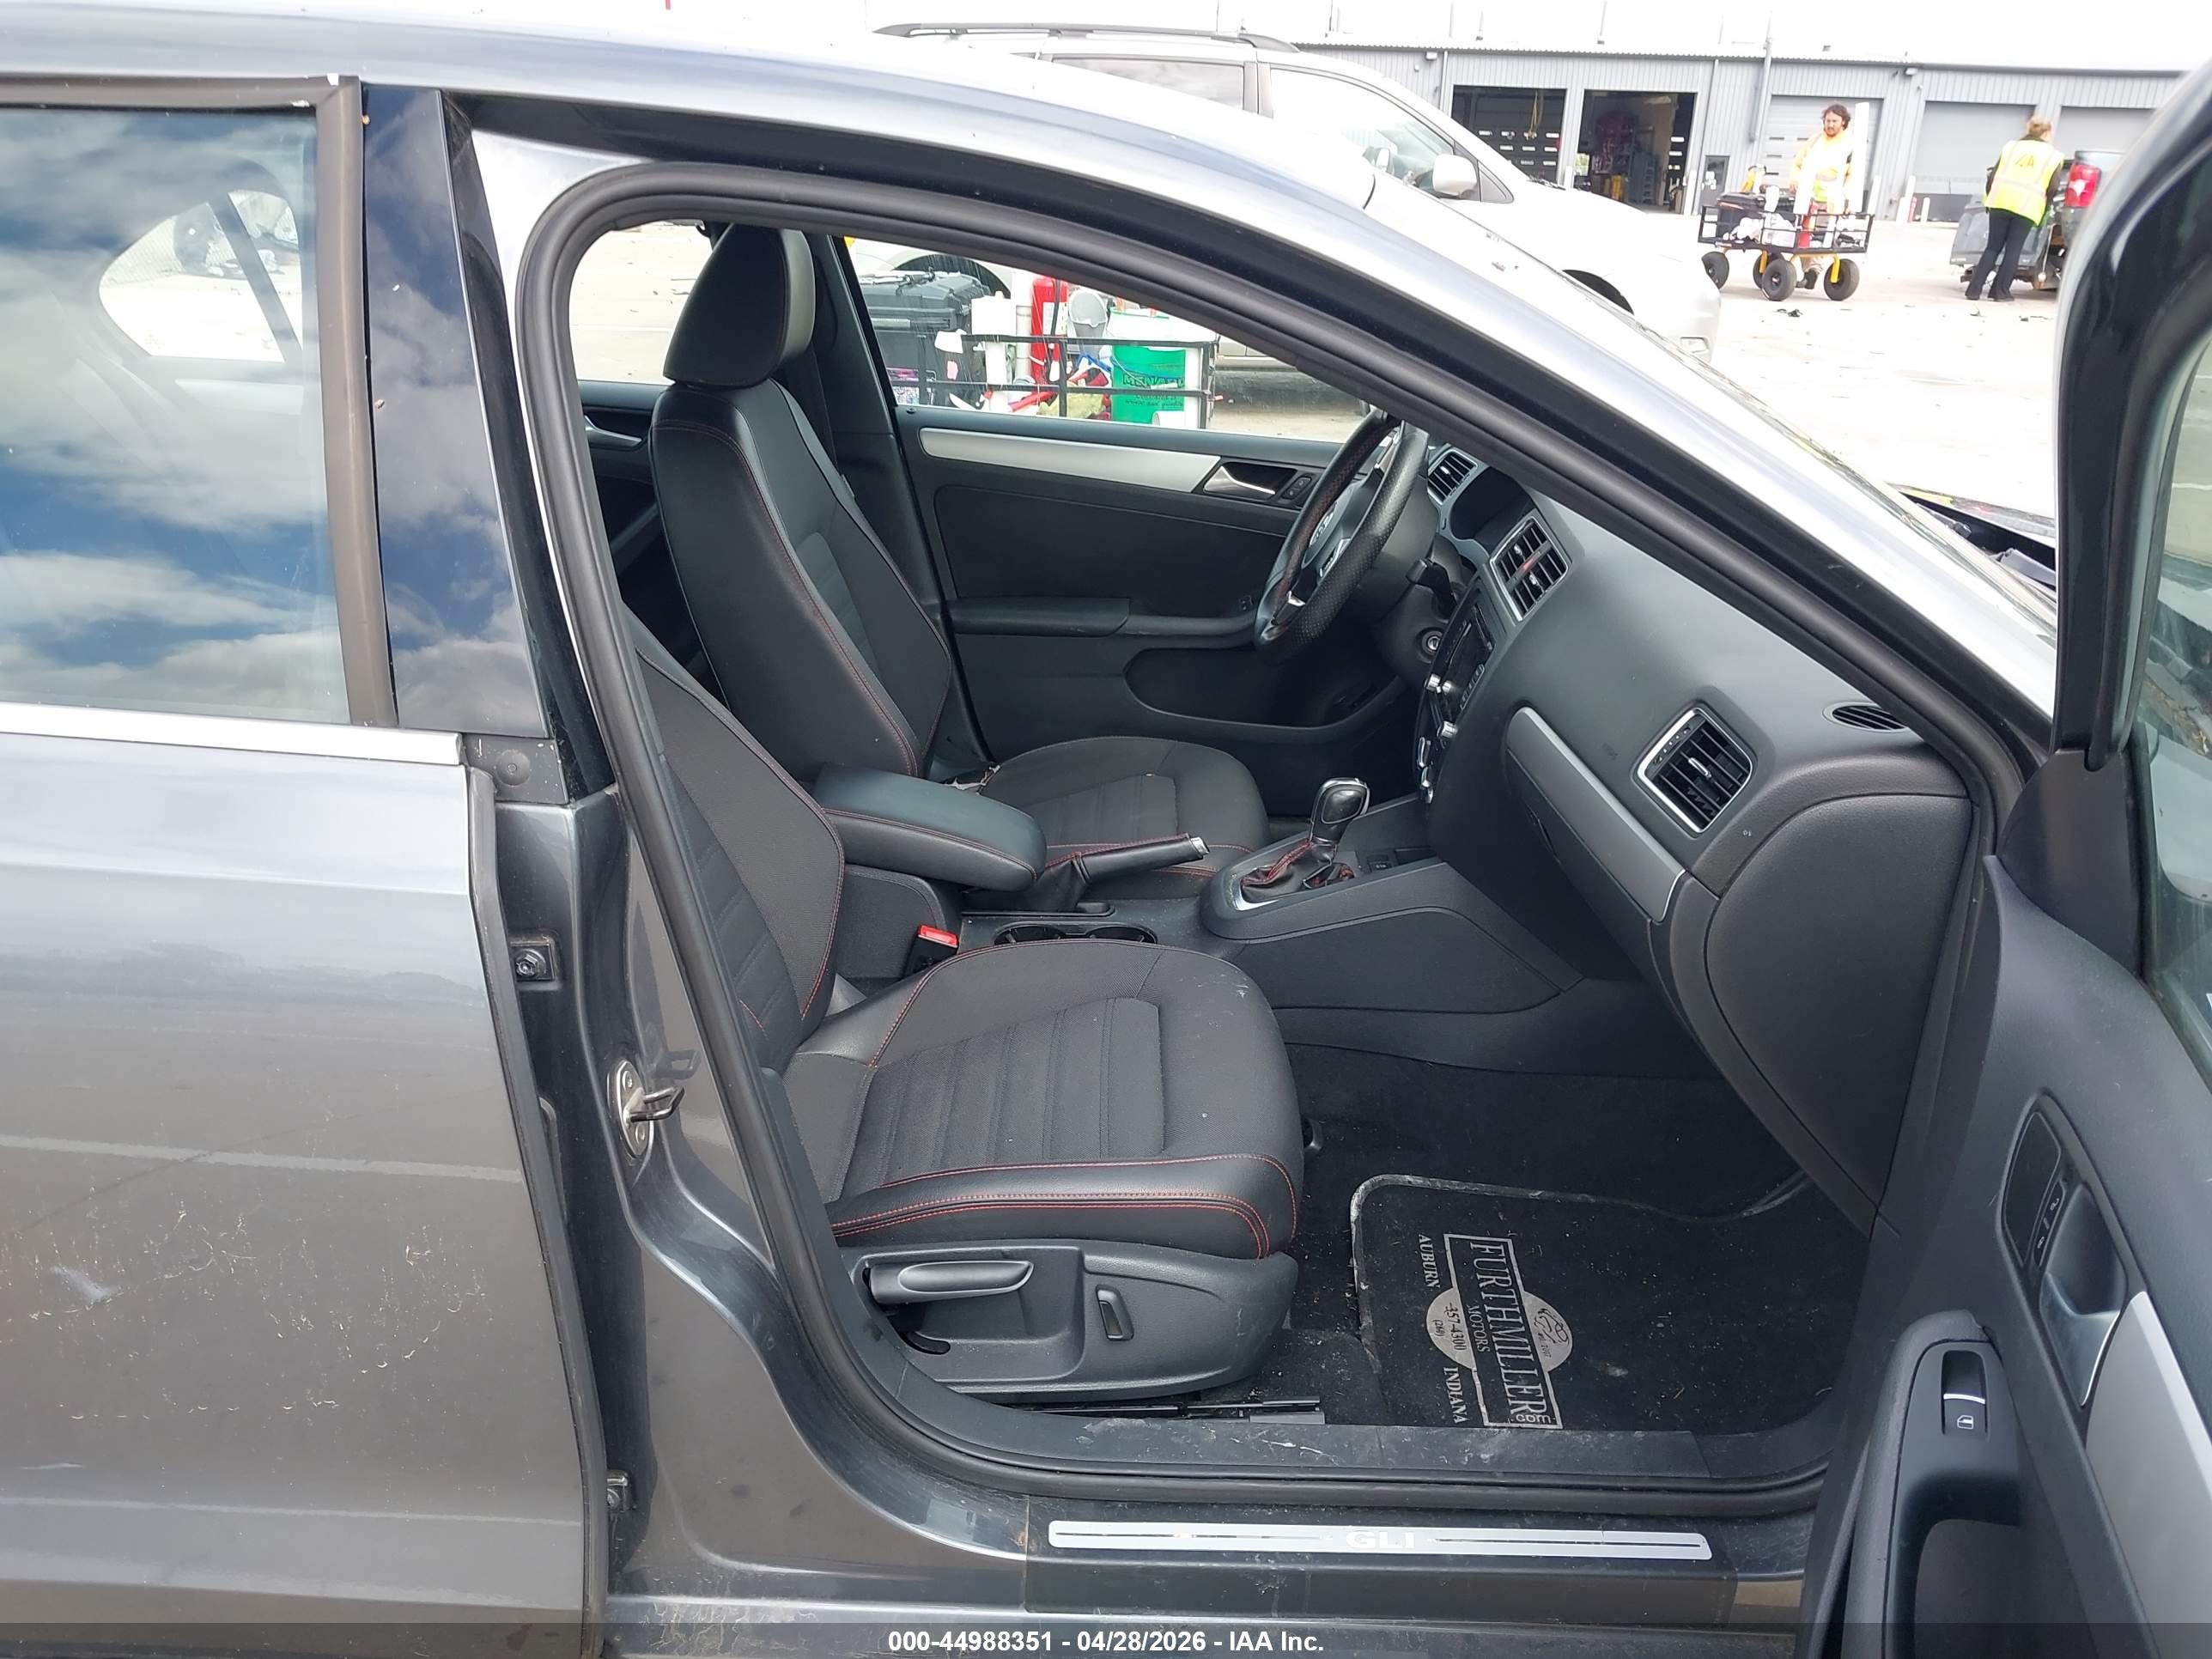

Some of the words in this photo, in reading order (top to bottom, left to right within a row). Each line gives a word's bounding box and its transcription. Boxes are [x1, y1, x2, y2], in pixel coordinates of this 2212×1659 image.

[1419, 1234, 1441, 1288] AUBURN
[1443, 1367, 1470, 1425] INDIANA
[1467, 1304, 1491, 1352] MOTORS
[1470, 1243, 1547, 1414] FURTHMILLER
[1346, 1530, 1415, 1549] GLI
